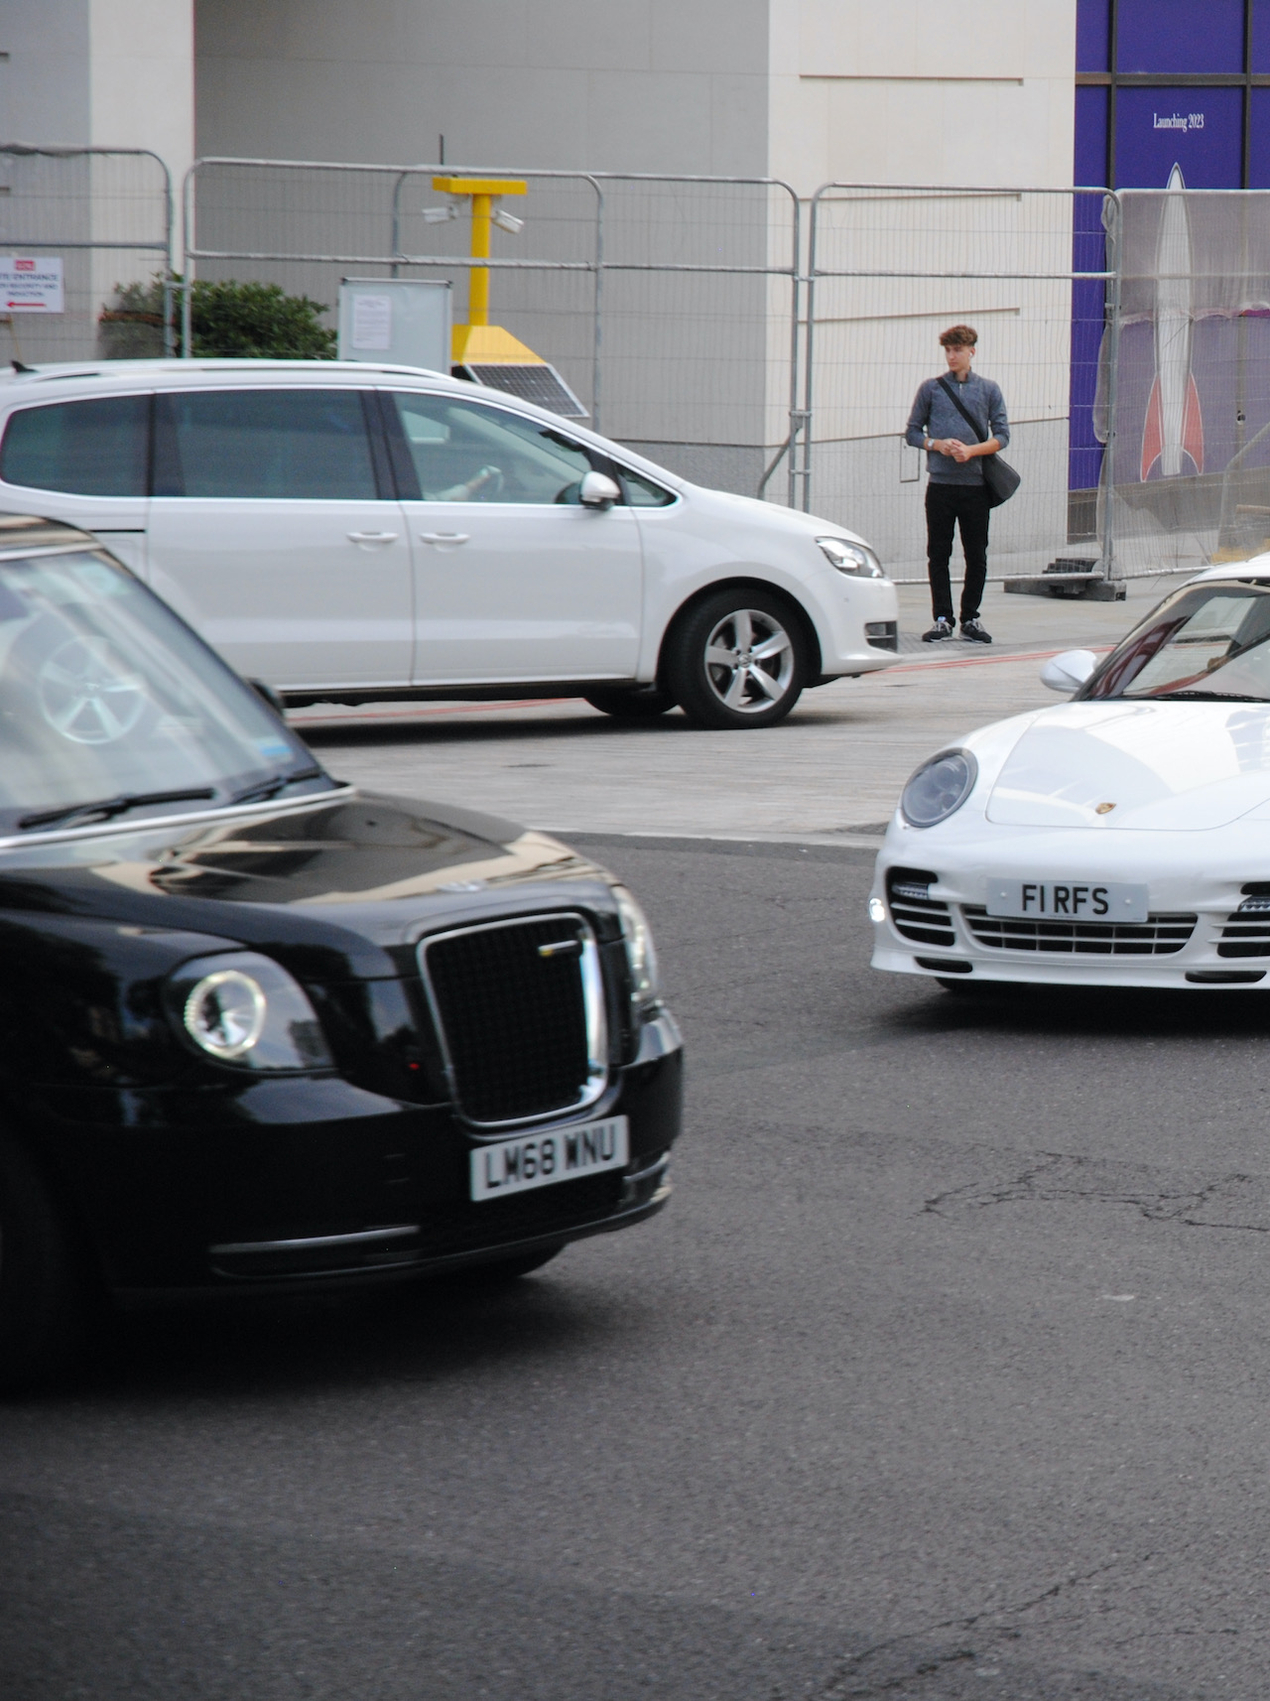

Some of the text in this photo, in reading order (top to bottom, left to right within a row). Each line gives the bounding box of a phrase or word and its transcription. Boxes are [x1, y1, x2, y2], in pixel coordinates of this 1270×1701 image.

[1153, 113, 1205, 132] Launching 2023
[484, 1123, 616, 1189] LM68 WNU
